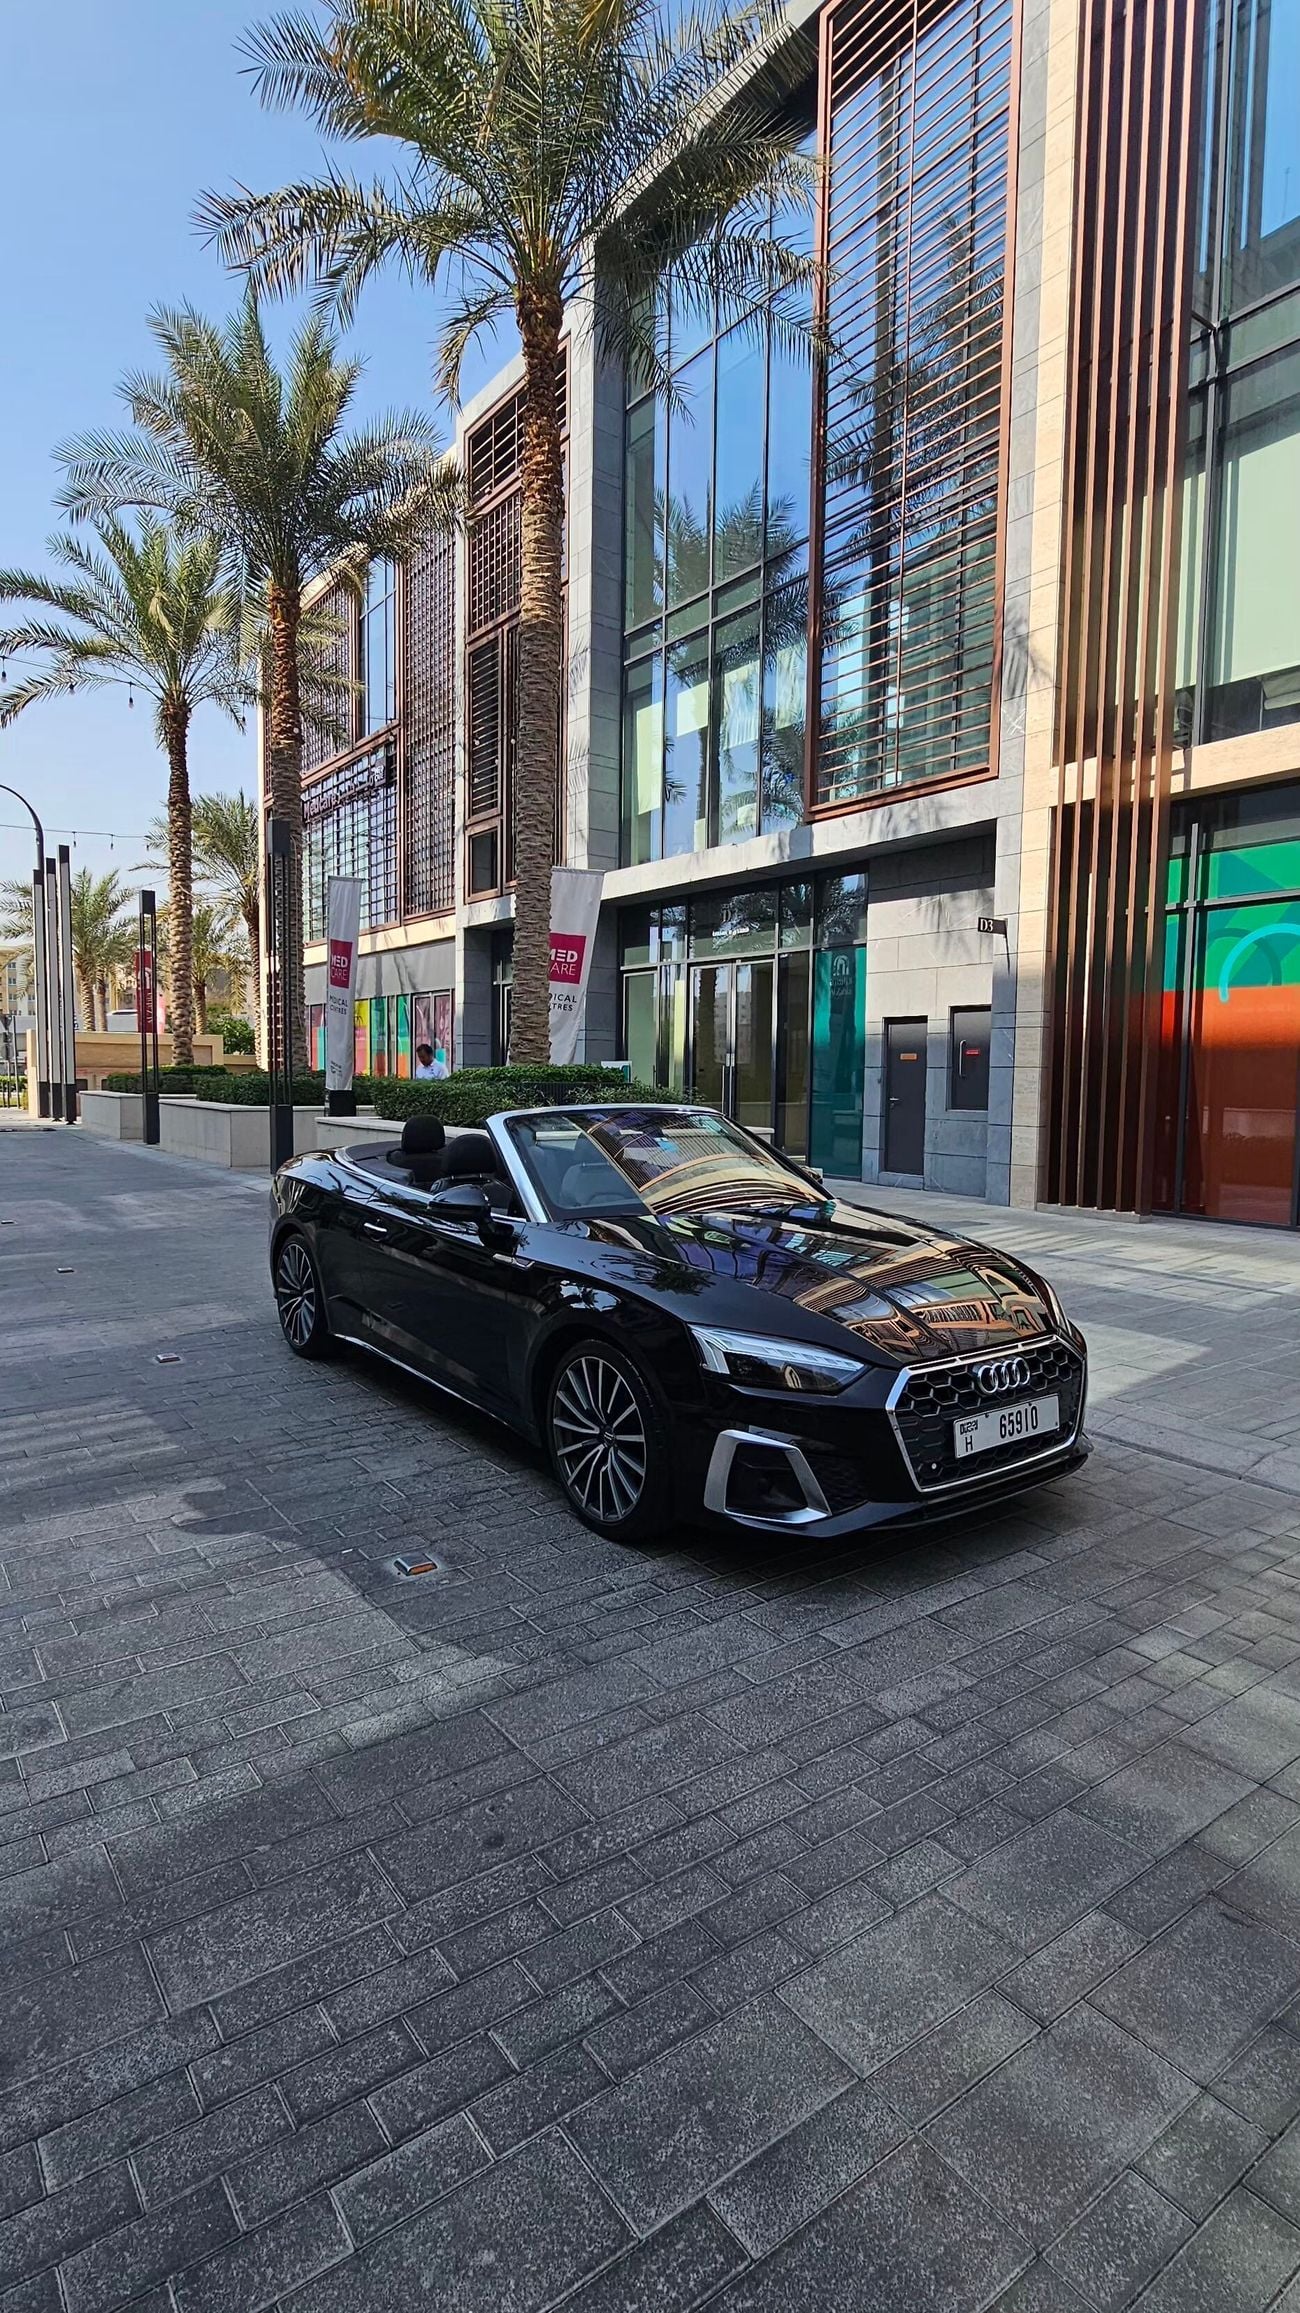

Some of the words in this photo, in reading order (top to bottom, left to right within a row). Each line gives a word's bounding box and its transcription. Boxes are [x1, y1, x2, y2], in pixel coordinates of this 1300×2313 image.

[980, 918, 994, 932] D3
[550, 962, 577, 976] ARE
[999, 1405, 1039, 1439] 65910
[964, 1435, 974, 1453] H
